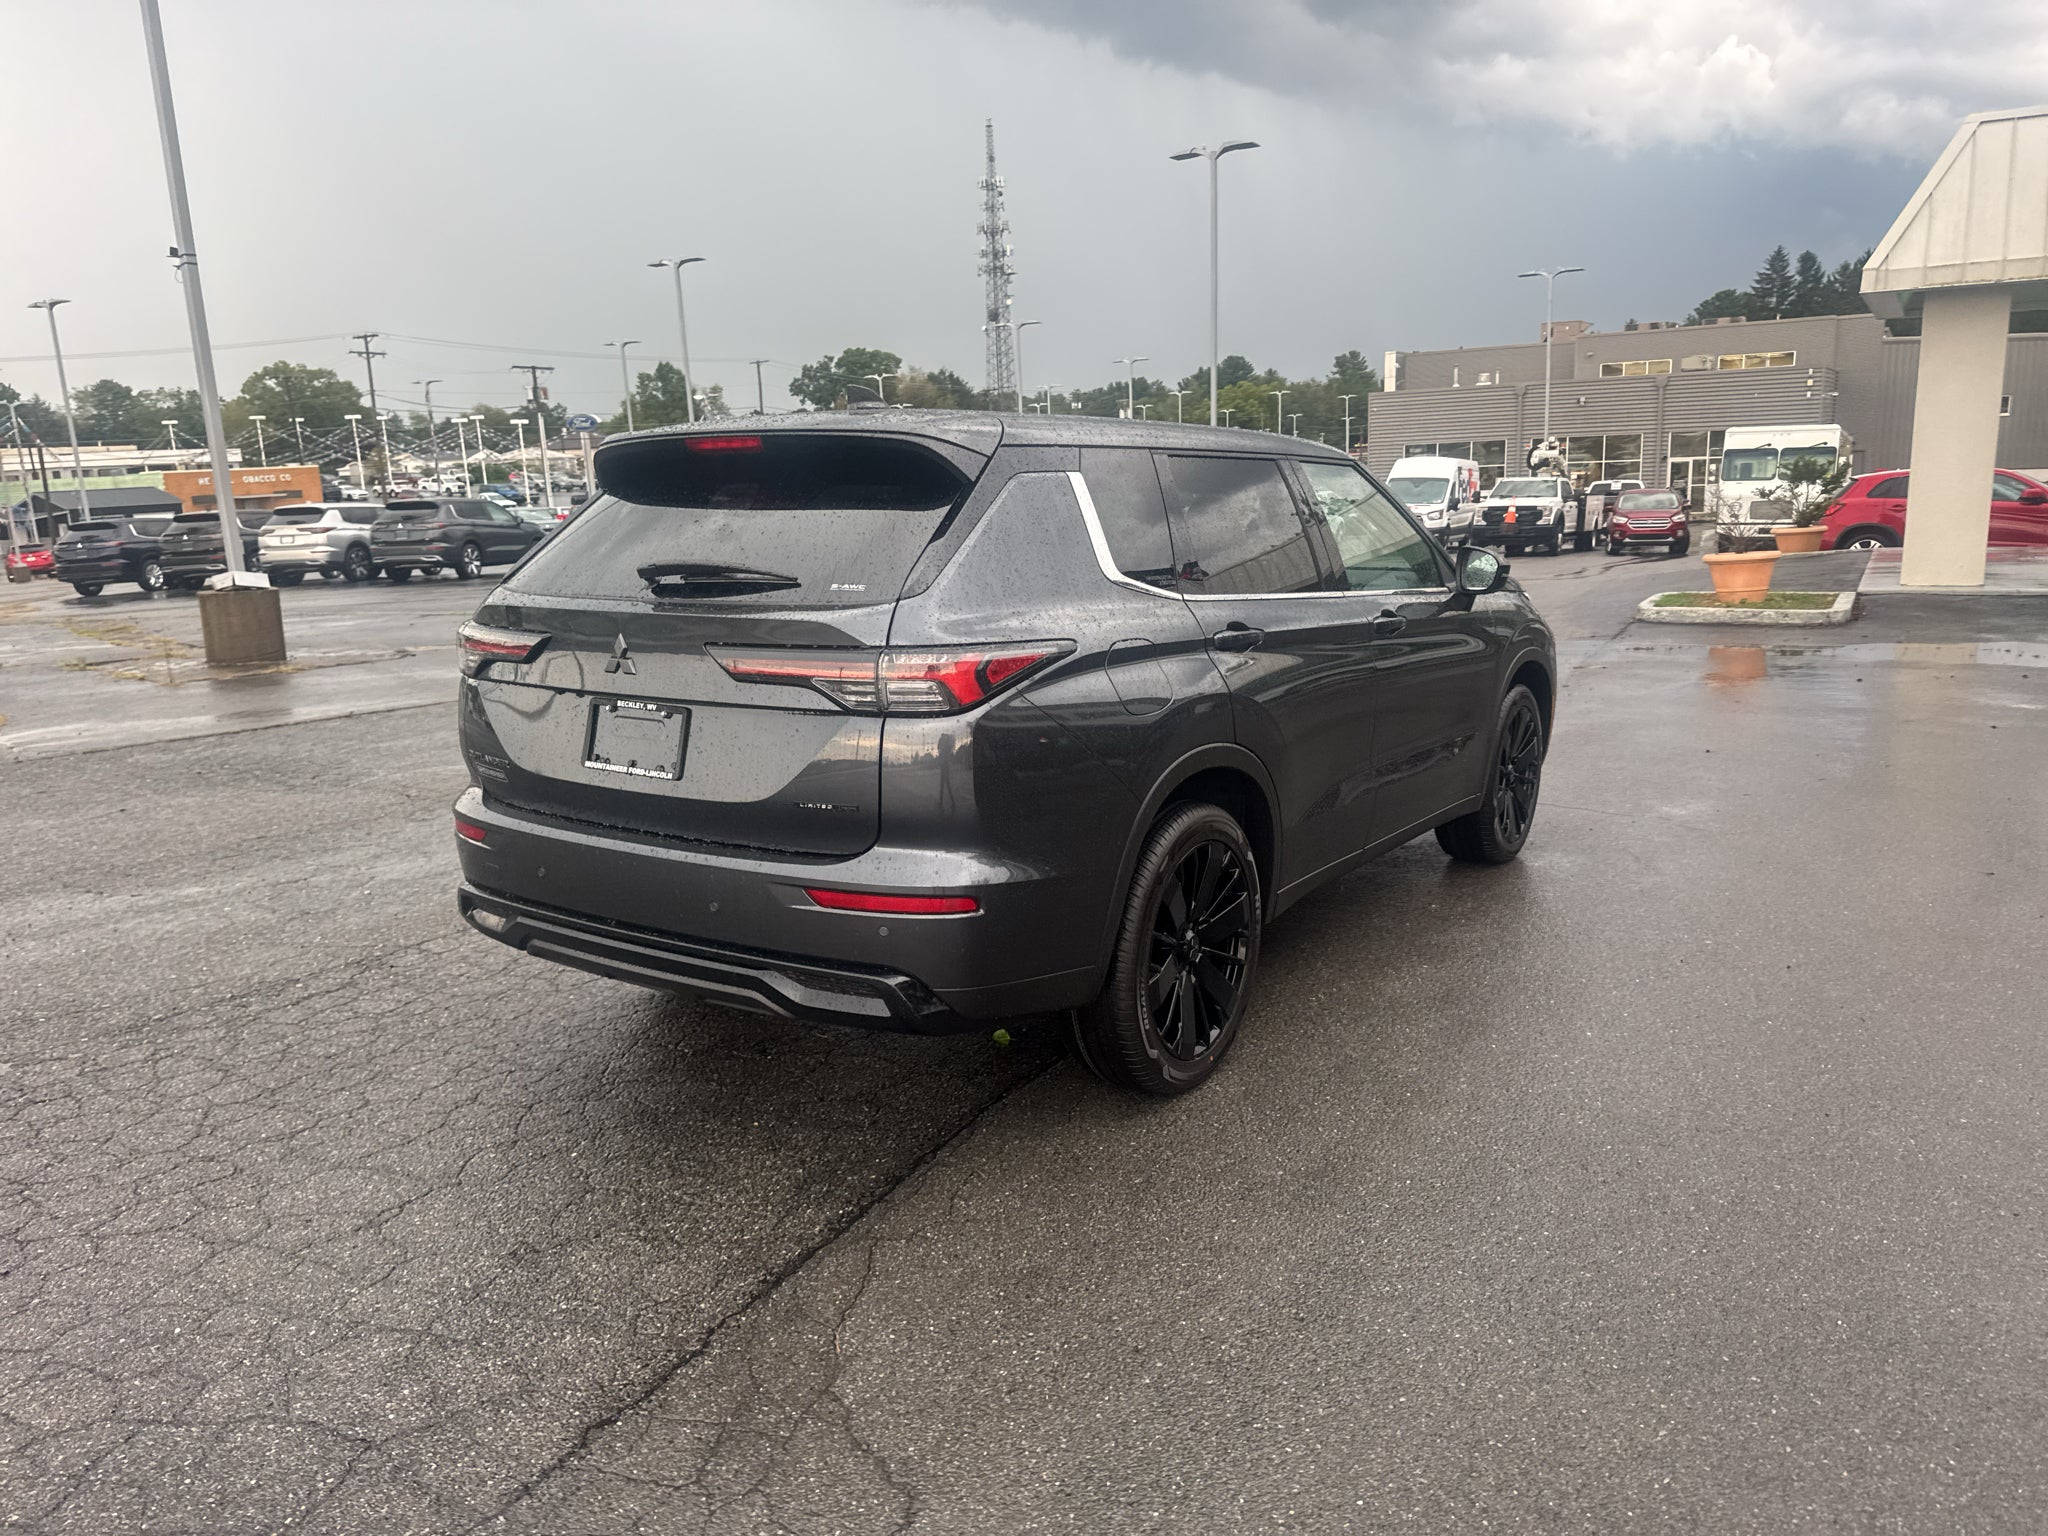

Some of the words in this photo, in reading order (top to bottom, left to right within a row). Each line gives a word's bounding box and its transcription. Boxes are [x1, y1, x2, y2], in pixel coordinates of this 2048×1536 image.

[617, 699, 646, 710] BECKLEY,
[584, 761, 628, 773] MOUNTAINEER
[628, 767, 673, 780] FORD-LINCOLN
[799, 802, 833, 810] LIMITED
